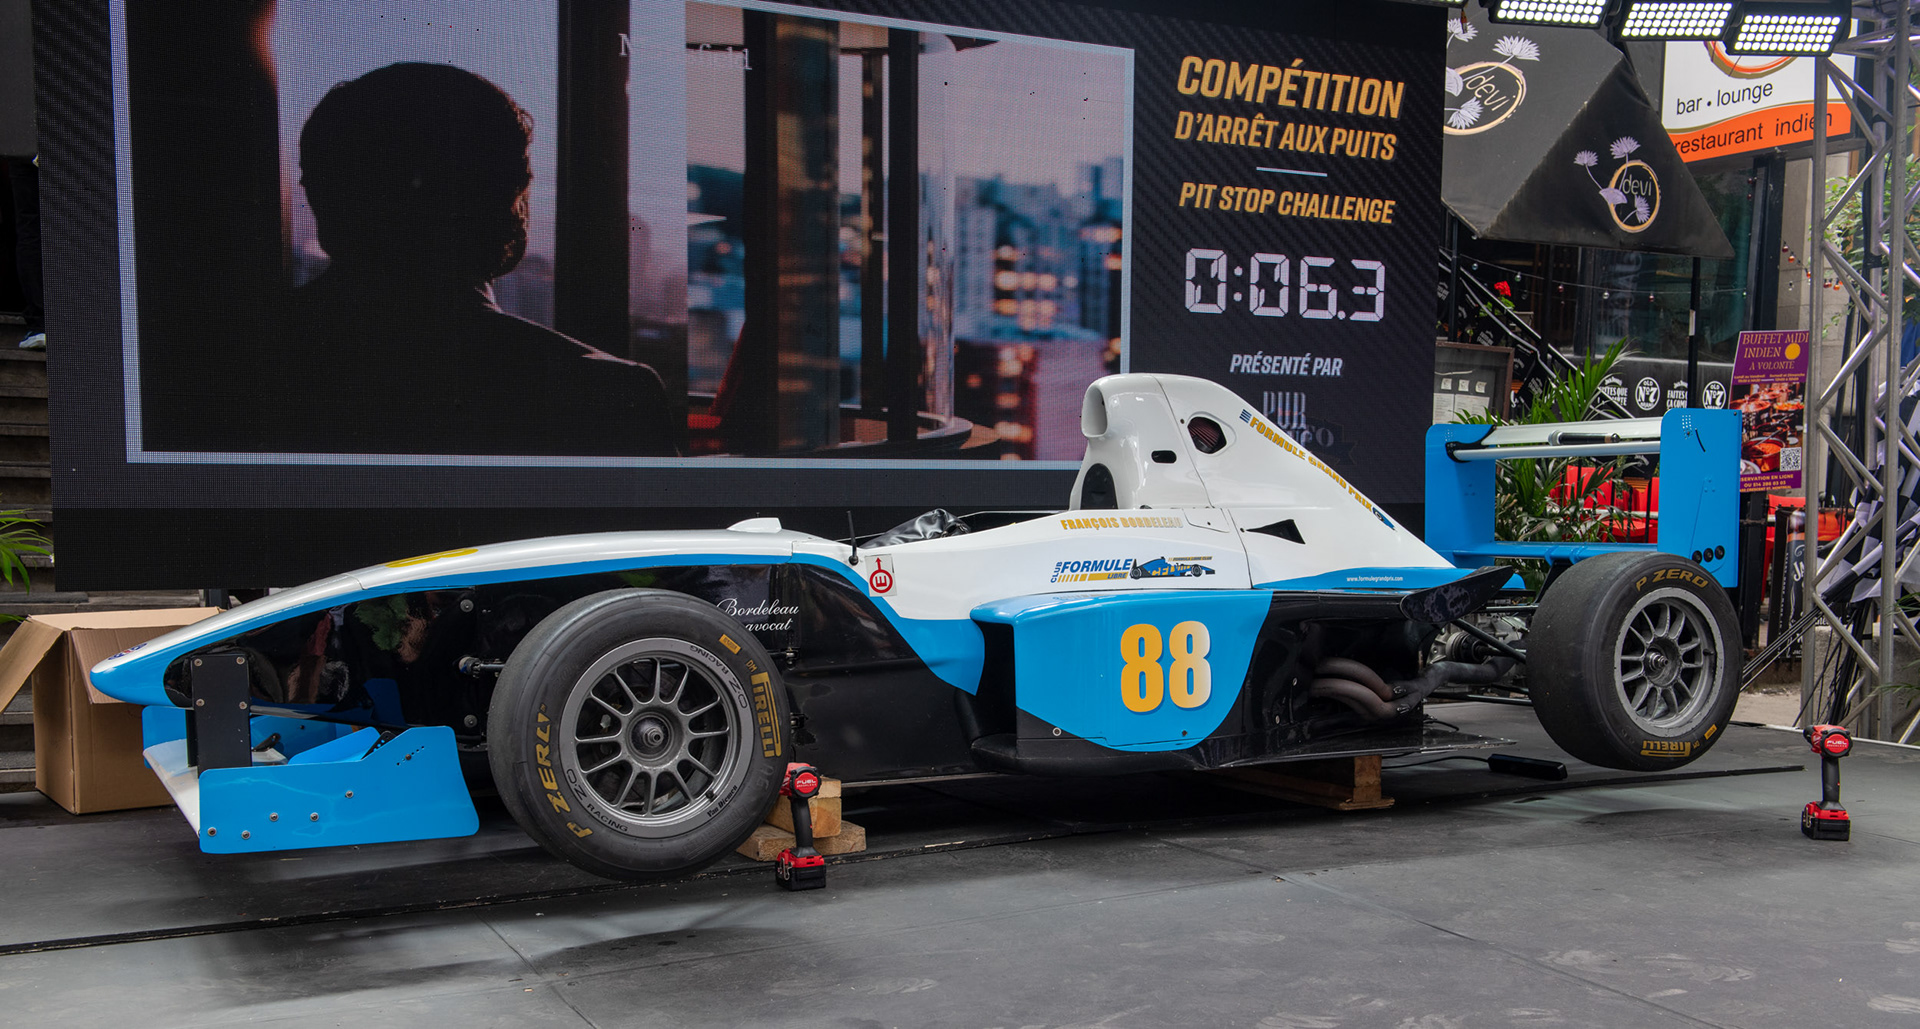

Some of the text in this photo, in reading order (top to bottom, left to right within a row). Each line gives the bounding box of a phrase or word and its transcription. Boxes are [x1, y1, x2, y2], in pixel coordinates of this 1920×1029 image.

[1177, 56, 1404, 118] COMPÉTITION
[1466, 75, 1516, 111] devi
[1676, 82, 1773, 115] bar lounge
[1278, 122, 1330, 154] AUX
[1330, 128, 1397, 161] PUITS
[1675, 122, 1763, 154] restaurant
[1622, 174, 1652, 196] devi
[1178, 182, 1397, 224] PIT STOP CHALLENGE
[1185, 248, 1386, 321] 0:06.3
[1742, 332, 1809, 345] BUFFET MIDI
[1229, 351, 1344, 377] PRÉSENTÉ PAR
[1744, 347, 1782, 358] INDIEN
[1249, 416, 1306, 460] FORMULE
[1308, 455, 1347, 489] GRAND
[1348, 485, 1373, 512] PRIX
[1060, 517, 1184, 530] FRANÇOIS BORDELEAU
[1050, 561, 1062, 583] CLUB
[1061, 558, 1133, 573] FORMULE
[1107, 572, 1127, 580] LIBRE
[1636, 568, 1708, 592] P ZERO
[716, 598, 799, 616] Bordeleau
[745, 618, 793, 631] avocat
[690, 645, 729, 675] RACING
[745, 660, 757, 672] DM
[1120, 620, 1212, 714] 88
[751, 672, 782, 758] PIRELLI
[1640, 740, 1691, 757] PIRELLI
[707, 785, 738, 817] Van Diemen
[587, 803, 628, 832] RACING
